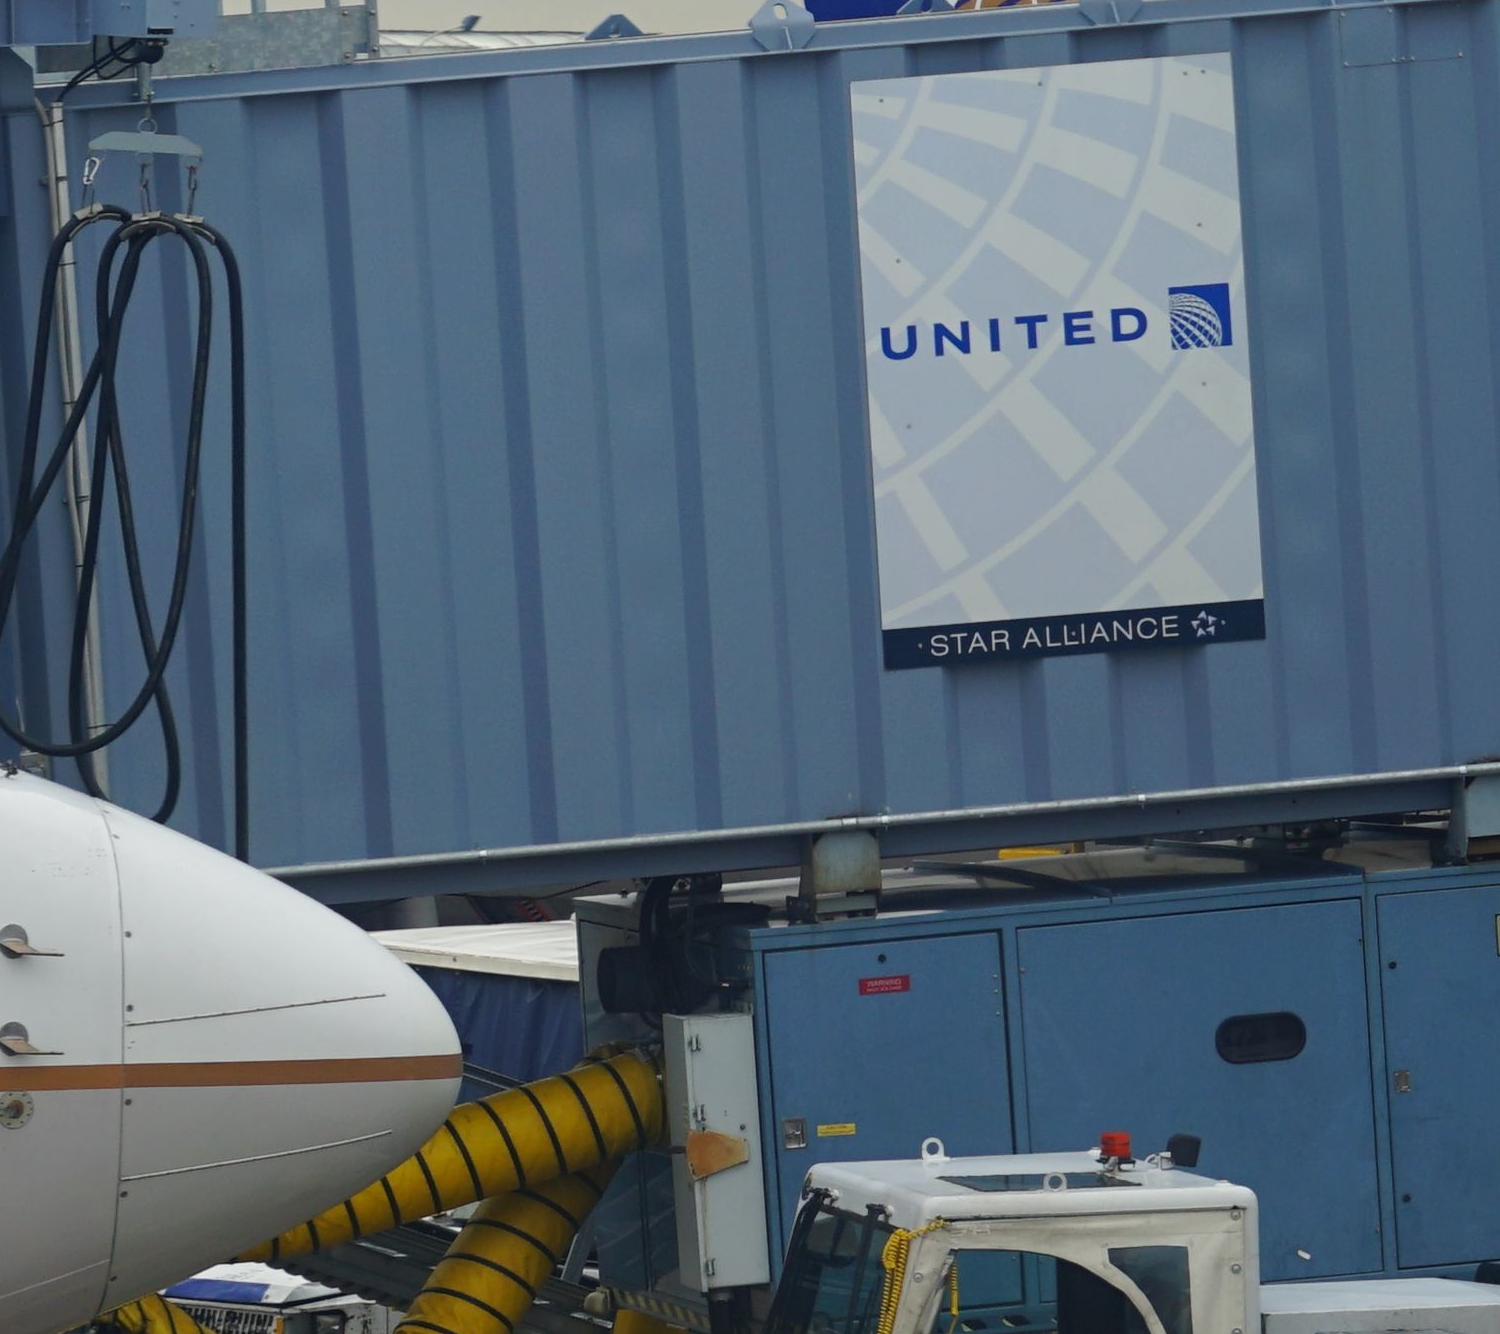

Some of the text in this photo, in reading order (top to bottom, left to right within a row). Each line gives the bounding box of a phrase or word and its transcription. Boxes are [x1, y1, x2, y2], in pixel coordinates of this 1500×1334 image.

[880, 307, 1148, 360] UNITED
[930, 616, 1180, 657] STAR ALLIANCE
